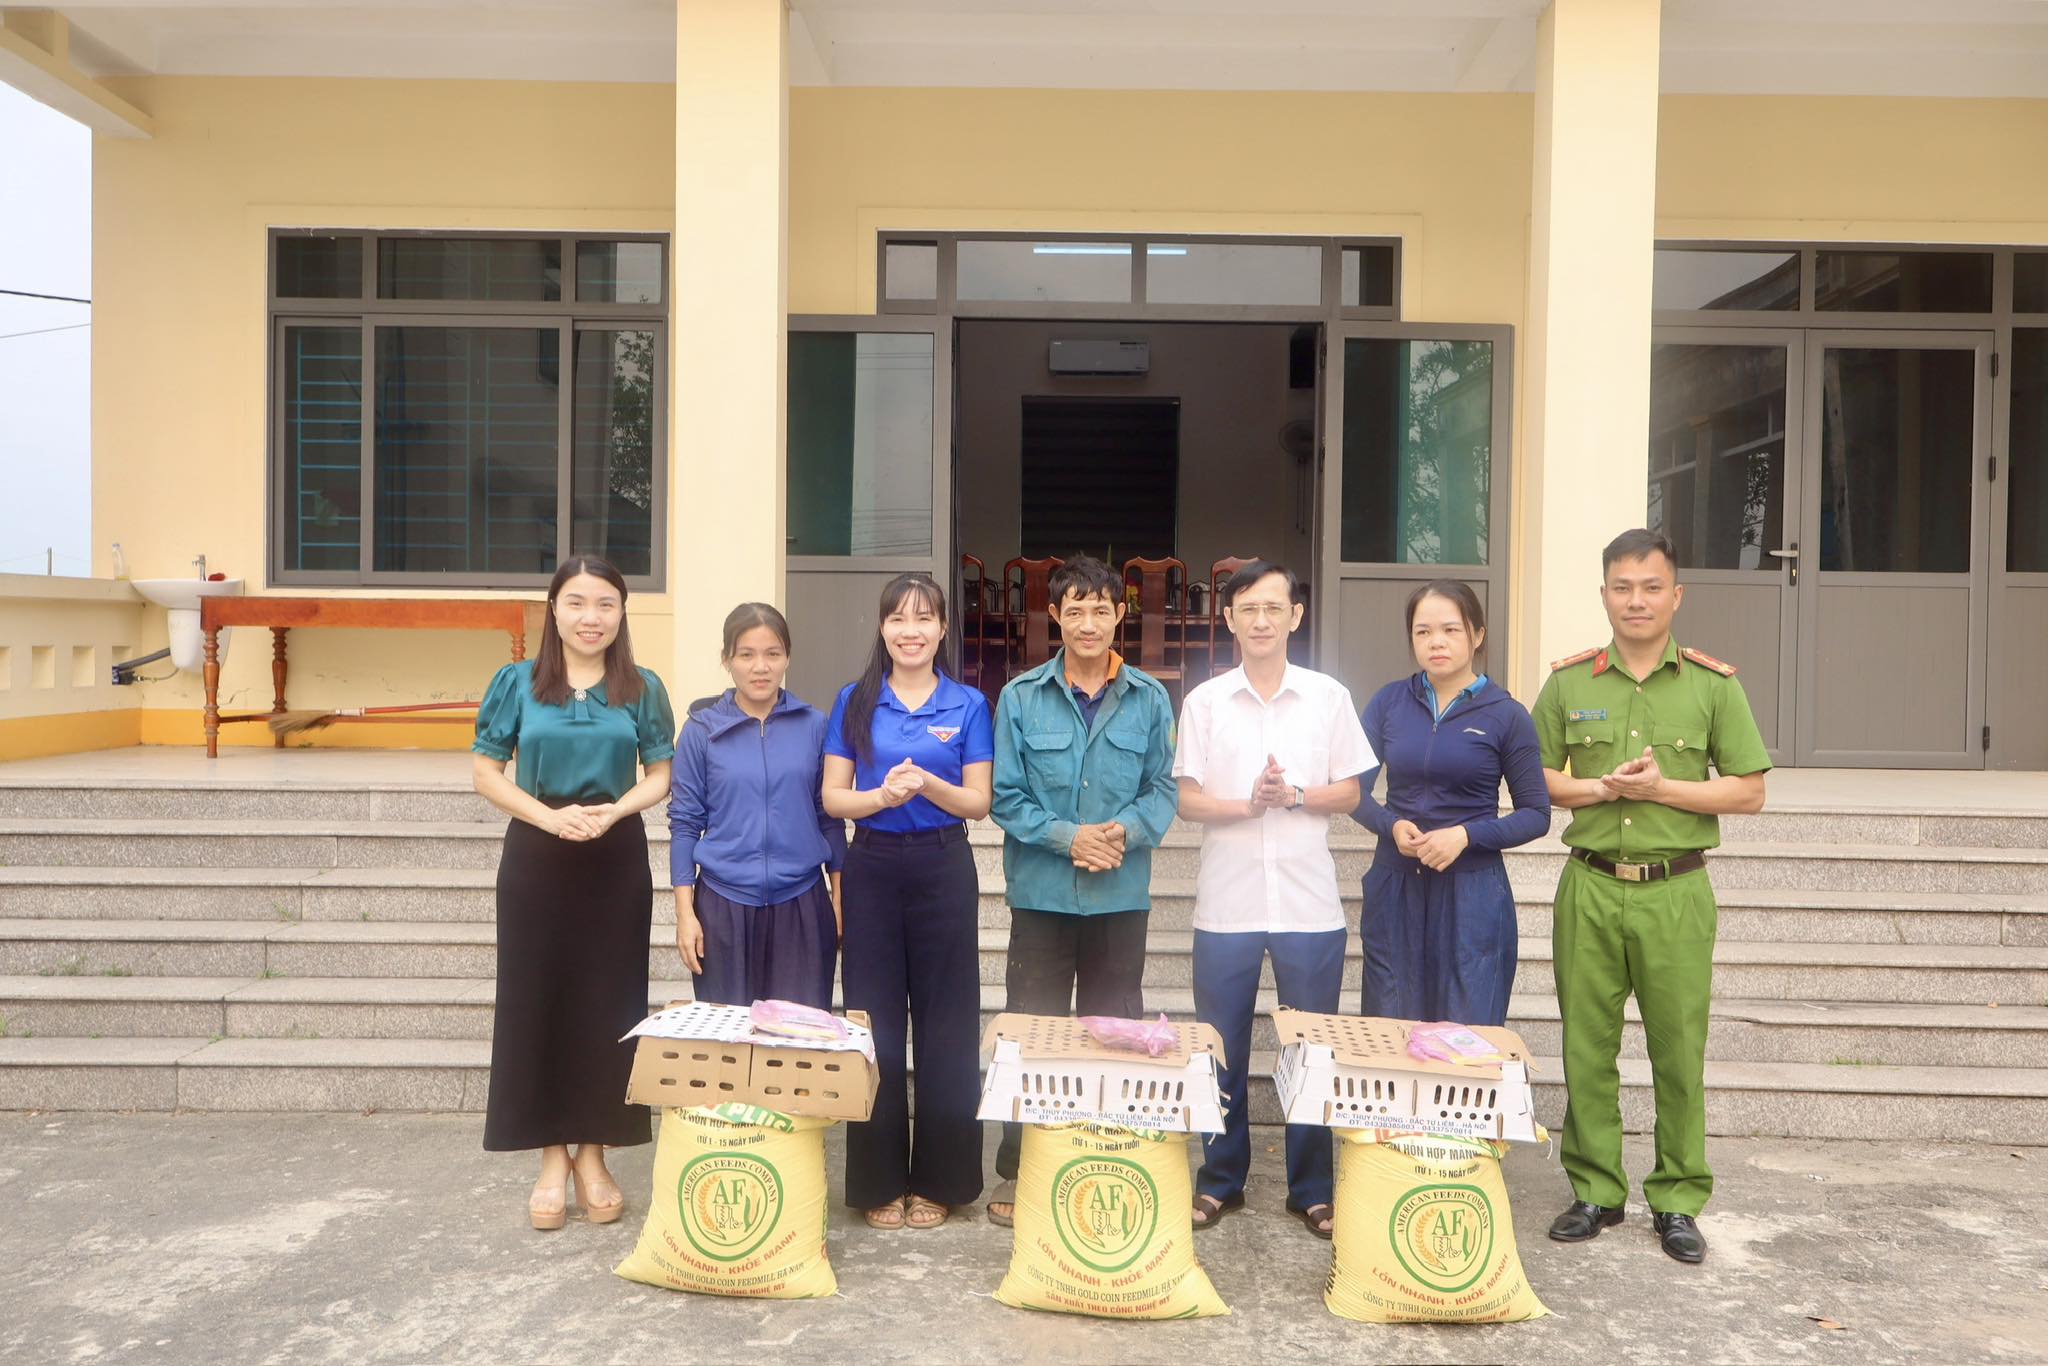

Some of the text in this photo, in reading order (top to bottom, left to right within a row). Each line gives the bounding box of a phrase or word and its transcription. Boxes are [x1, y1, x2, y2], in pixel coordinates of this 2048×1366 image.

[720, 1138, 727, 1147] 15
[728, 1135, 746, 1147] NGÀY
[1096, 1142, 1103, 1151] 15
[1104, 1141, 1123, 1152] NGÀY
[684, 1160, 777, 1203] AMERICAN FEEDS COMPANY
[1439, 1170, 1447, 1178] 15
[1448, 1167, 1466, 1178] NGÀY
[712, 1178, 746, 1205] AF
[1058, 1164, 1153, 1211] AMERICAN FEEDS COMPANY
[1089, 1184, 1124, 1211] AF
[1397, 1191, 1489, 1233] AMERICAN FEEDS COMPANY
[1431, 1208, 1466, 1236] AF
[680, 1250, 718, 1274] NHANH
[763, 1230, 797, 1260] MẠNH
[1058, 1259, 1101, 1287] NHANH
[1145, 1240, 1174, 1272] MẠNH
[676, 1268, 694, 1281] TNHH
[696, 1275, 716, 1285] GOLD
[717, 1278, 736, 1287] COIN
[737, 1273, 776, 1287] FEEDMILL
[1045, 1275, 1054, 1287] TY
[1056, 1280, 1076, 1296] TNHH
[1078, 1288, 1099, 1301] GOLD
[1100, 1292, 1120, 1303] COIN
[1122, 1286, 1160, 1303] FEEDMILL
[1362, 1290, 1384, 1307] CÔNG
[1386, 1300, 1396, 1310] TY
[1398, 1302, 1420, 1314] TNHH
[1421, 1306, 1444, 1316] GOLD
[1444, 1310, 1464, 1318] COIN
[1466, 1298, 1502, 1316] FEEDMILL
[1400, 1284, 1445, 1306] NHANH
